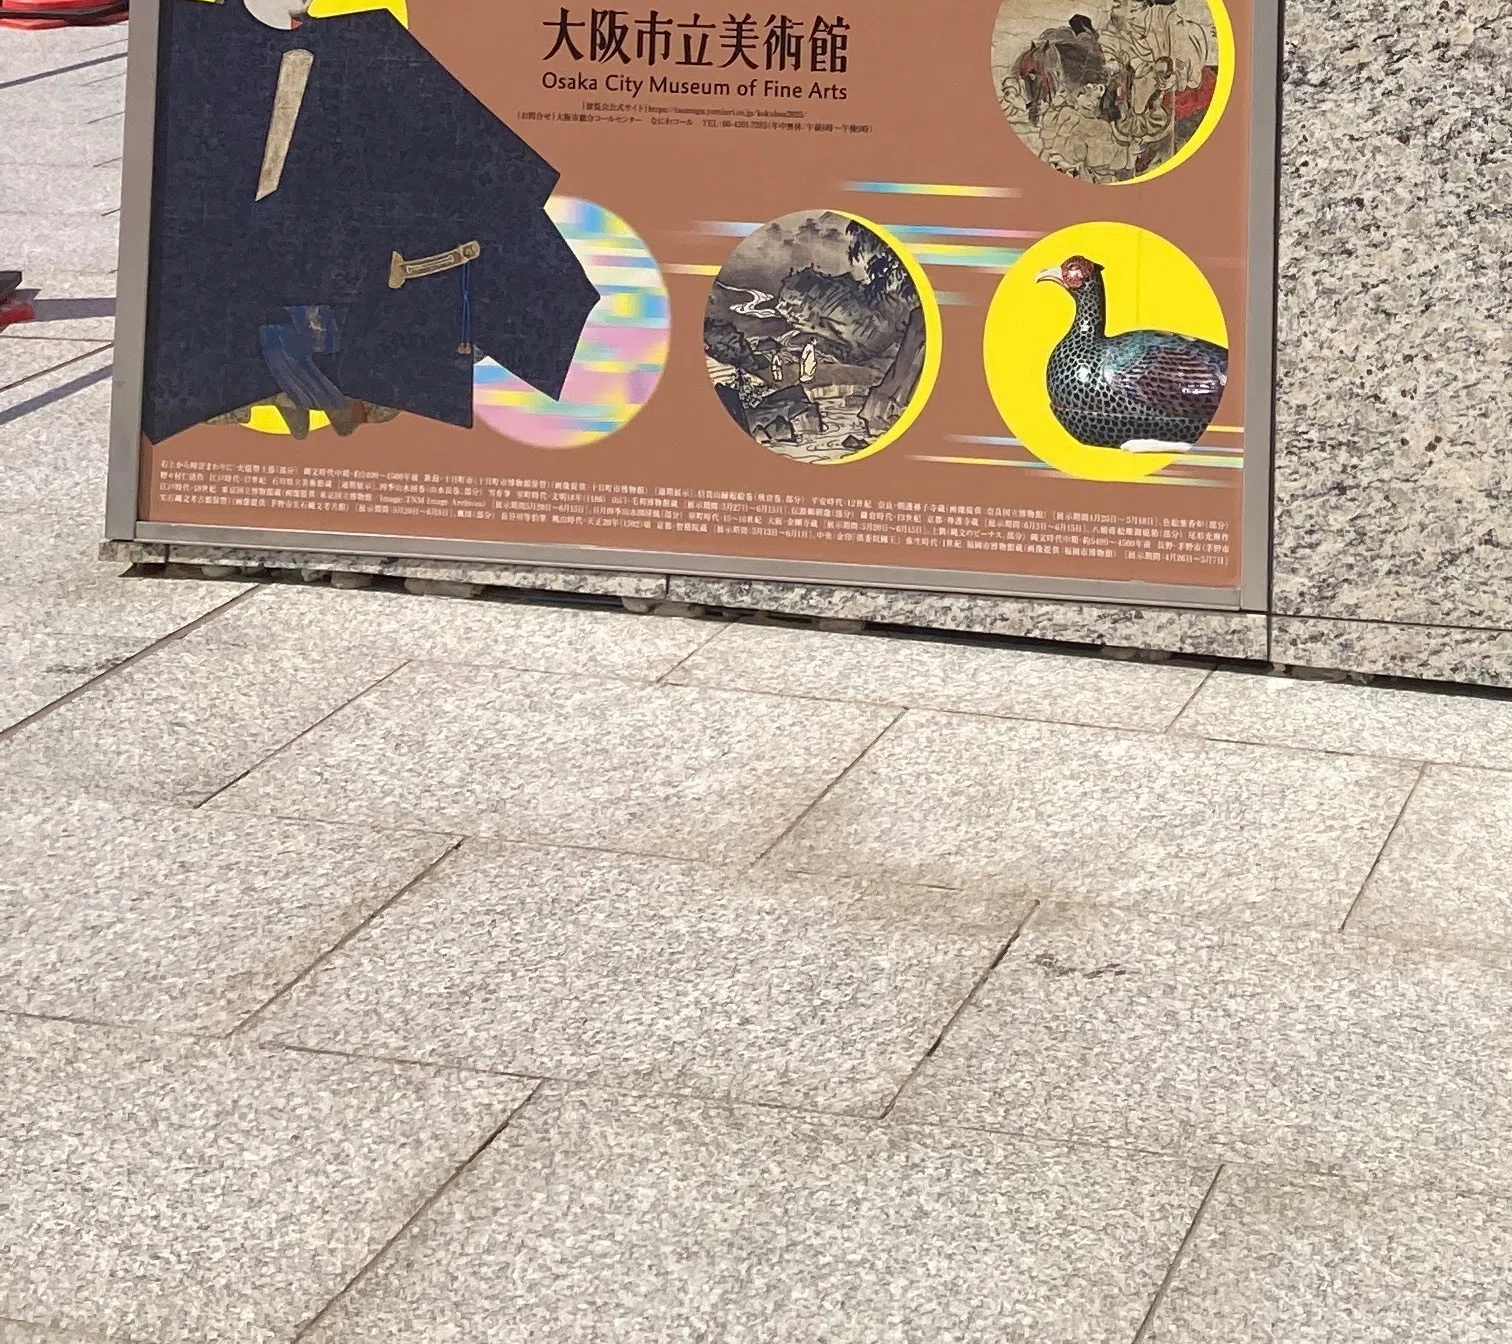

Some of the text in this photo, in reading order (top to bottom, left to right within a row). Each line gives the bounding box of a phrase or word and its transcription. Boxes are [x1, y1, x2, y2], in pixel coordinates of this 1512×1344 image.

[542, 7, 850, 74] 大阪市立美術館
[542, 71, 848, 100] Osaka City Museum of Fine Arts
